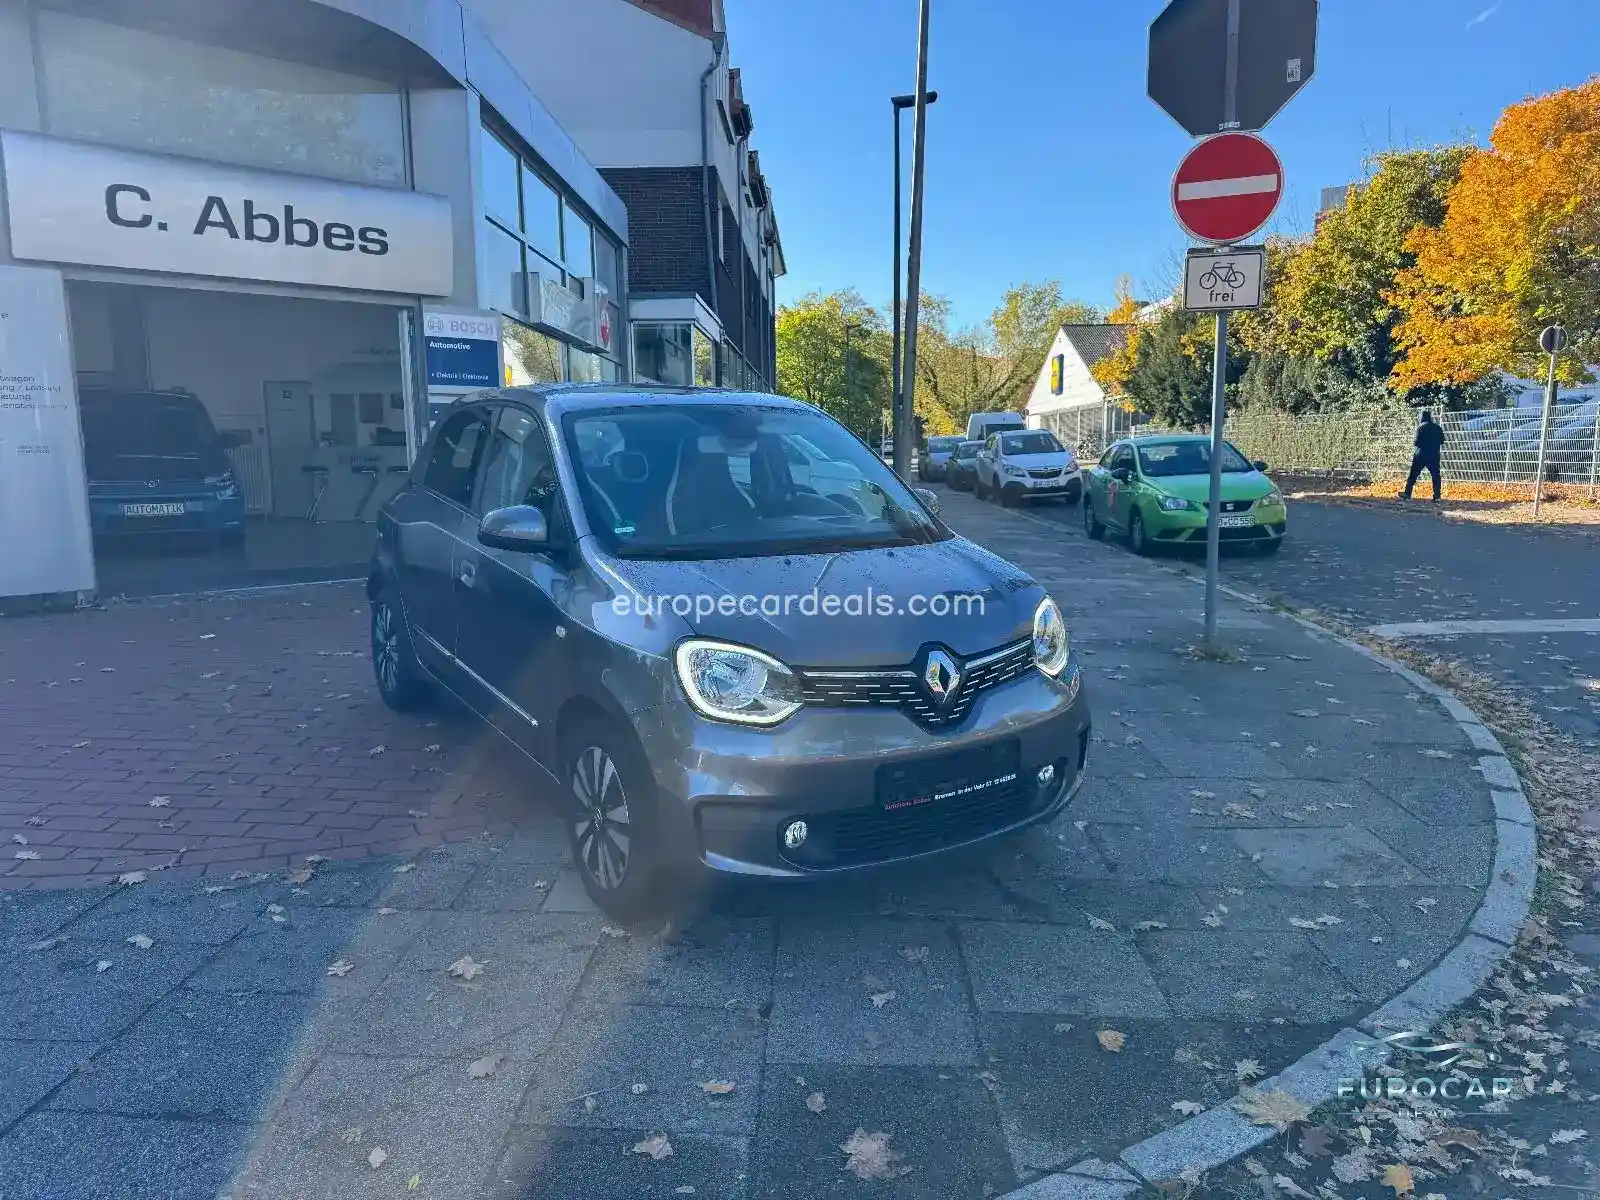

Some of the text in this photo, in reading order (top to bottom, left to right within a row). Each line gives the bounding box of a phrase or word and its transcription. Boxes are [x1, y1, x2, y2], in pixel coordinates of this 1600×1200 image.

[105, 183, 389, 256] C. Abbes
[1209, 289, 1234, 302] frei
[450, 320, 493, 334] BOSCH
[429, 340, 471, 350] Automotive
[126, 504, 183, 514] AUTOMATIK
